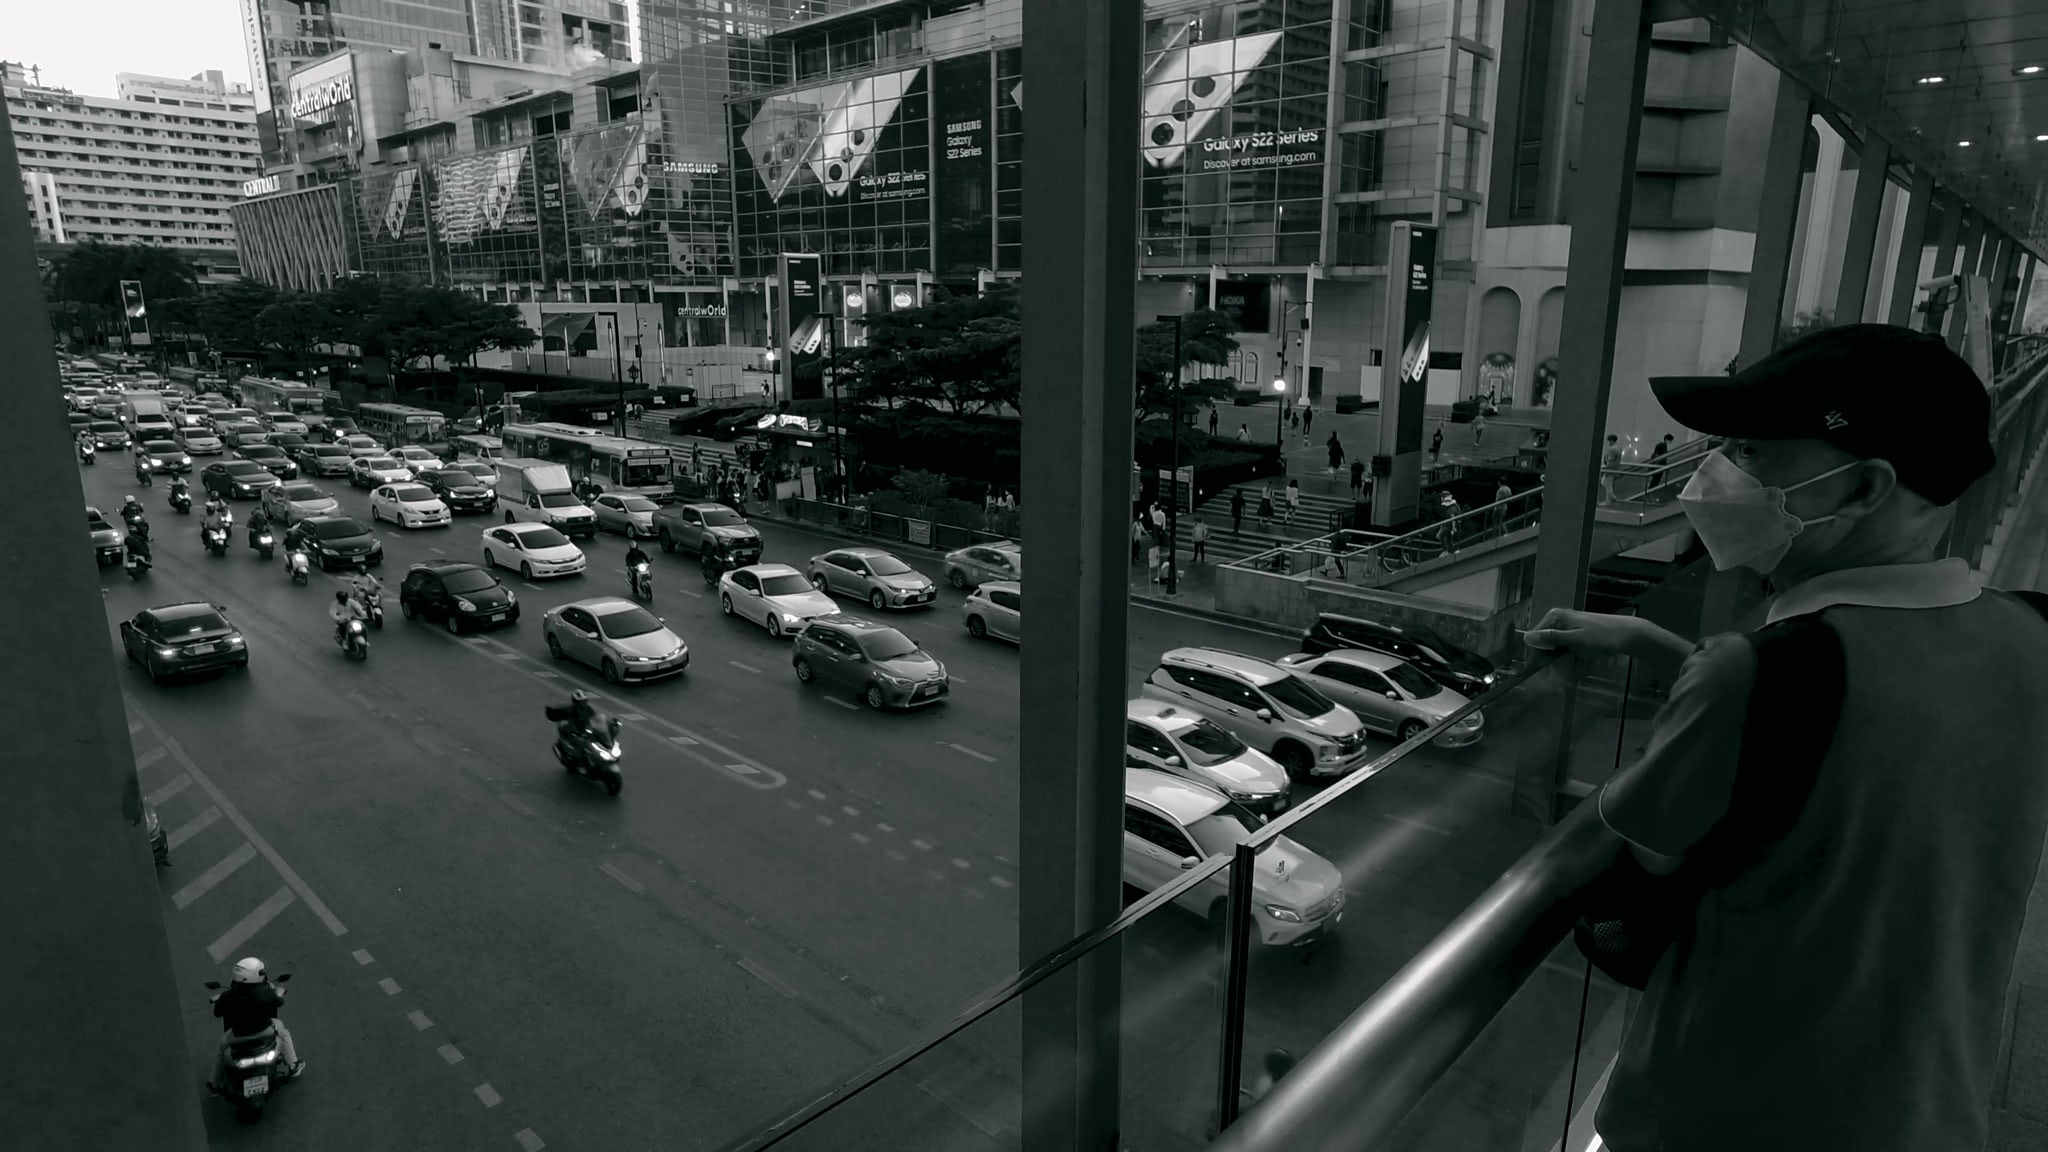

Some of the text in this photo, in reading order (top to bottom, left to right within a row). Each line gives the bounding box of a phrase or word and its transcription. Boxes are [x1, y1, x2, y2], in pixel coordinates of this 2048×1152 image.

[946, 119, 982, 134] SAMSUNG
[946, 135, 973, 147] Galaxy
[1203, 127, 1319, 153] Galaxy S22 Series
[959, 145, 983, 158] Series
[663, 161, 719, 174] SAMSUNG
[1240, 156, 1251, 167] at
